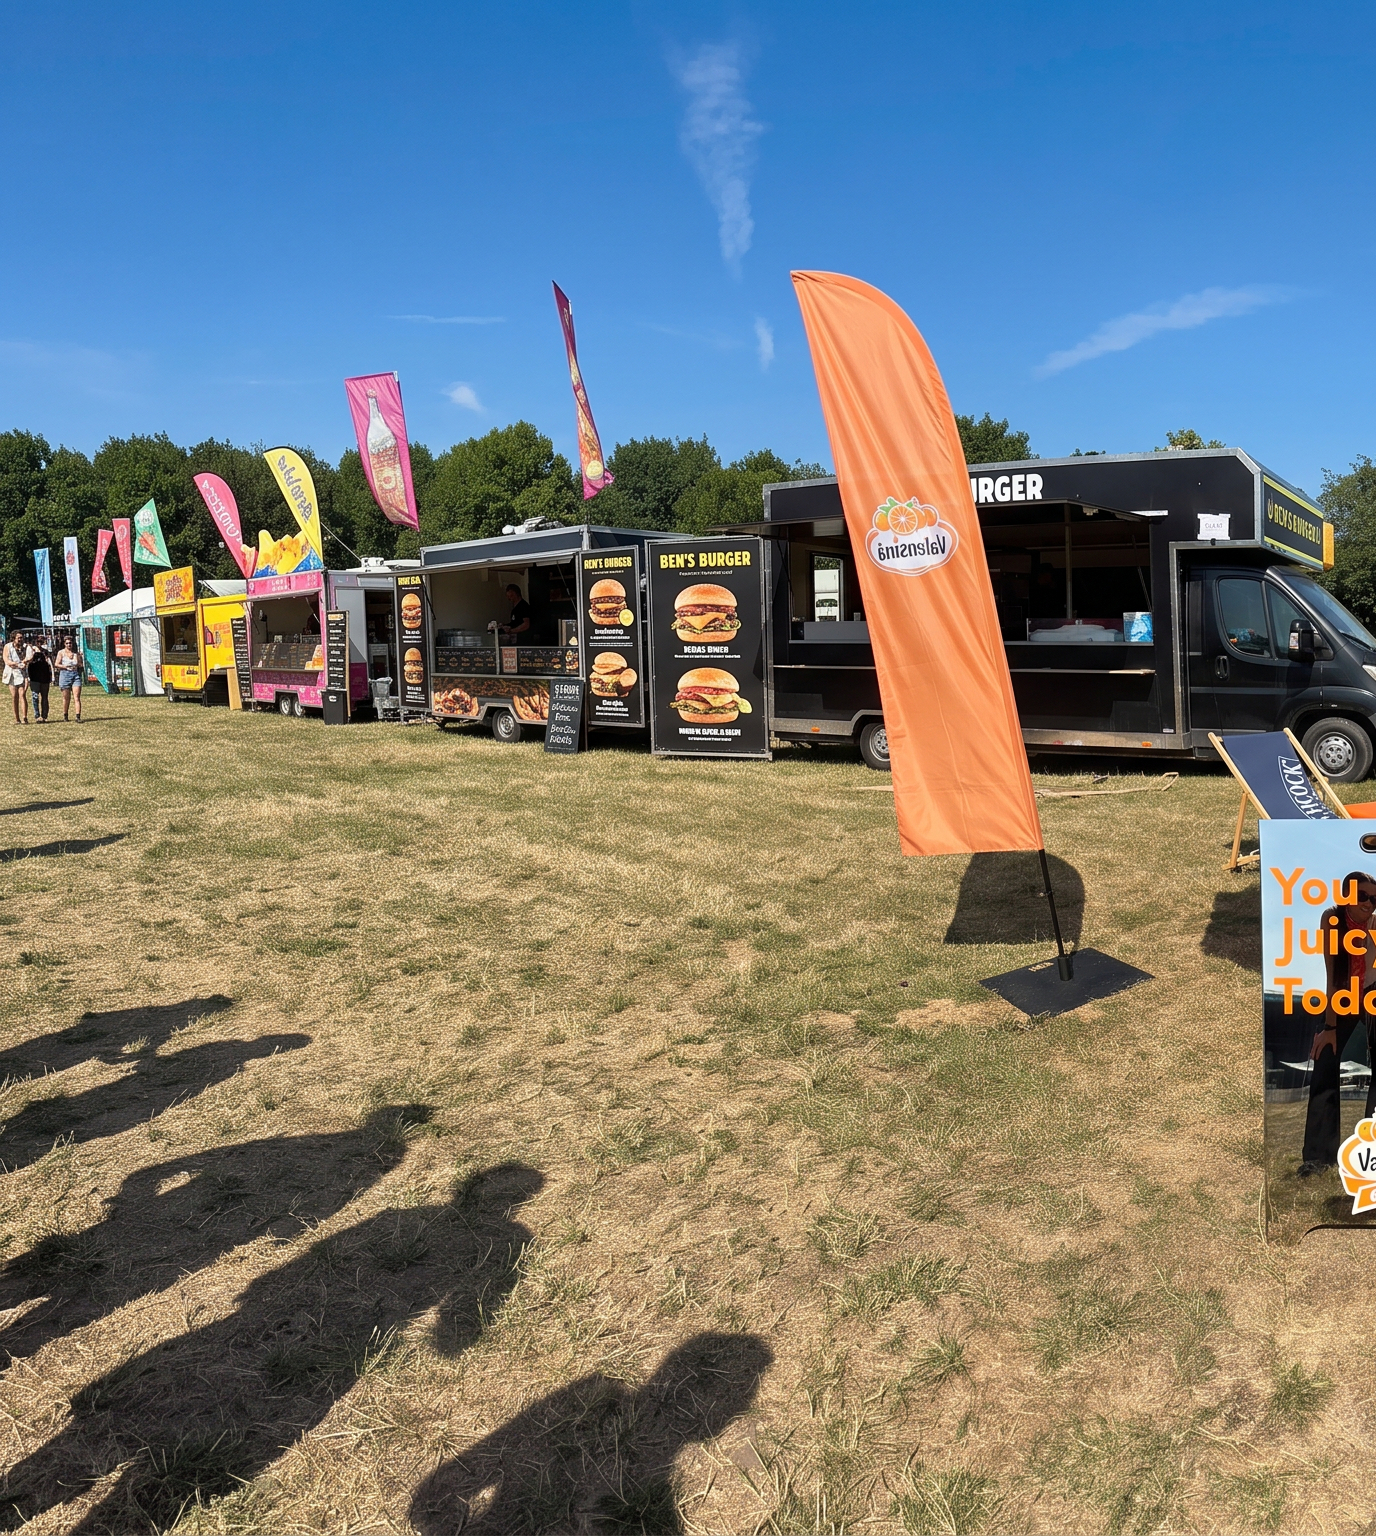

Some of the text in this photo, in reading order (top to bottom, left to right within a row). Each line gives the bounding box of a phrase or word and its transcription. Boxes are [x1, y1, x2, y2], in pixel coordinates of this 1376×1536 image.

[660, 551, 752, 569] BEN'S BURGER
[1269, 867, 1359, 906] You
